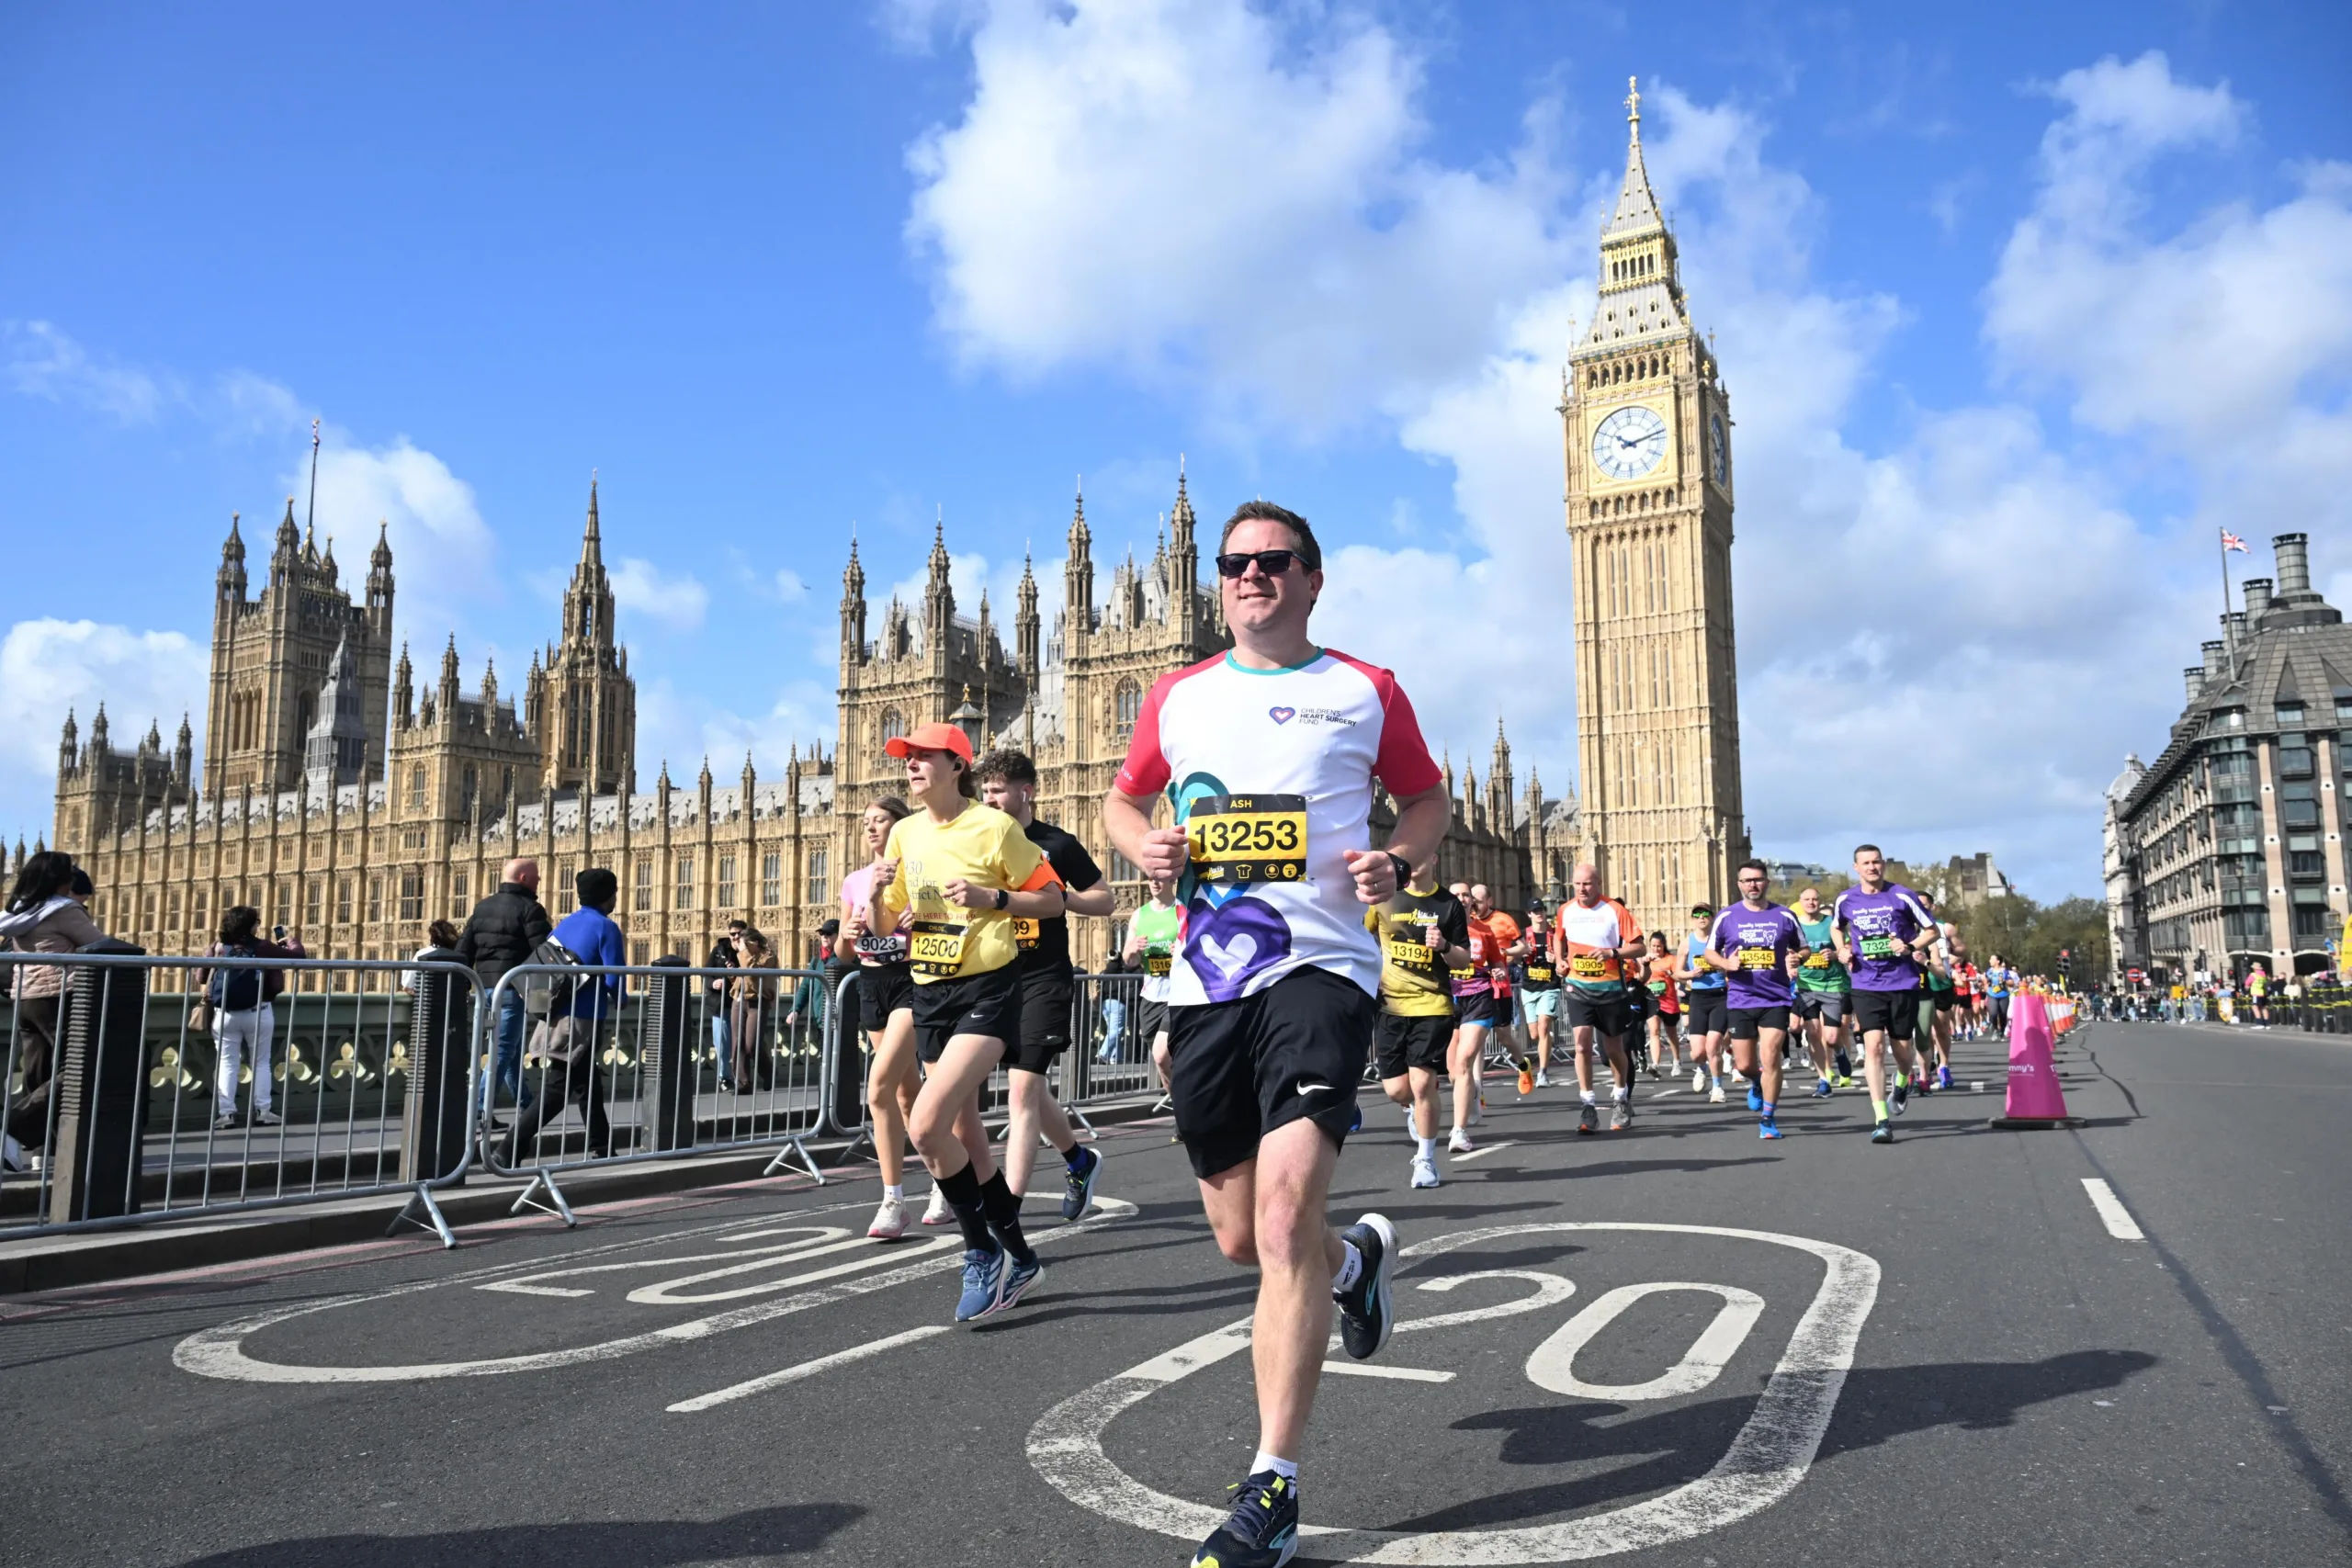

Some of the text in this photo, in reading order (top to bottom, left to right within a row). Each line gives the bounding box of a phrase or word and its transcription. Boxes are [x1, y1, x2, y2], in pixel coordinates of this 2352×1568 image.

[1301, 708, 1340, 716] CHILDREN'S
[1325, 716, 1357, 727] SURGERY
[1230, 800, 1252, 808] ASH
[1194, 819, 1298, 853] 13253
[922, 877, 937, 887] for
[956, 913, 977, 921] HELP
[861, 937, 898, 952] 9023
[916, 937, 959, 958] 12500
[1394, 944, 1430, 960] 13194
[1742, 953, 1772, 962] 13545
[2008, 1064, 2035, 1073] mmy's
[472, 1226, 965, 1304] 20
[1321, 1270, 1767, 1401] 20
